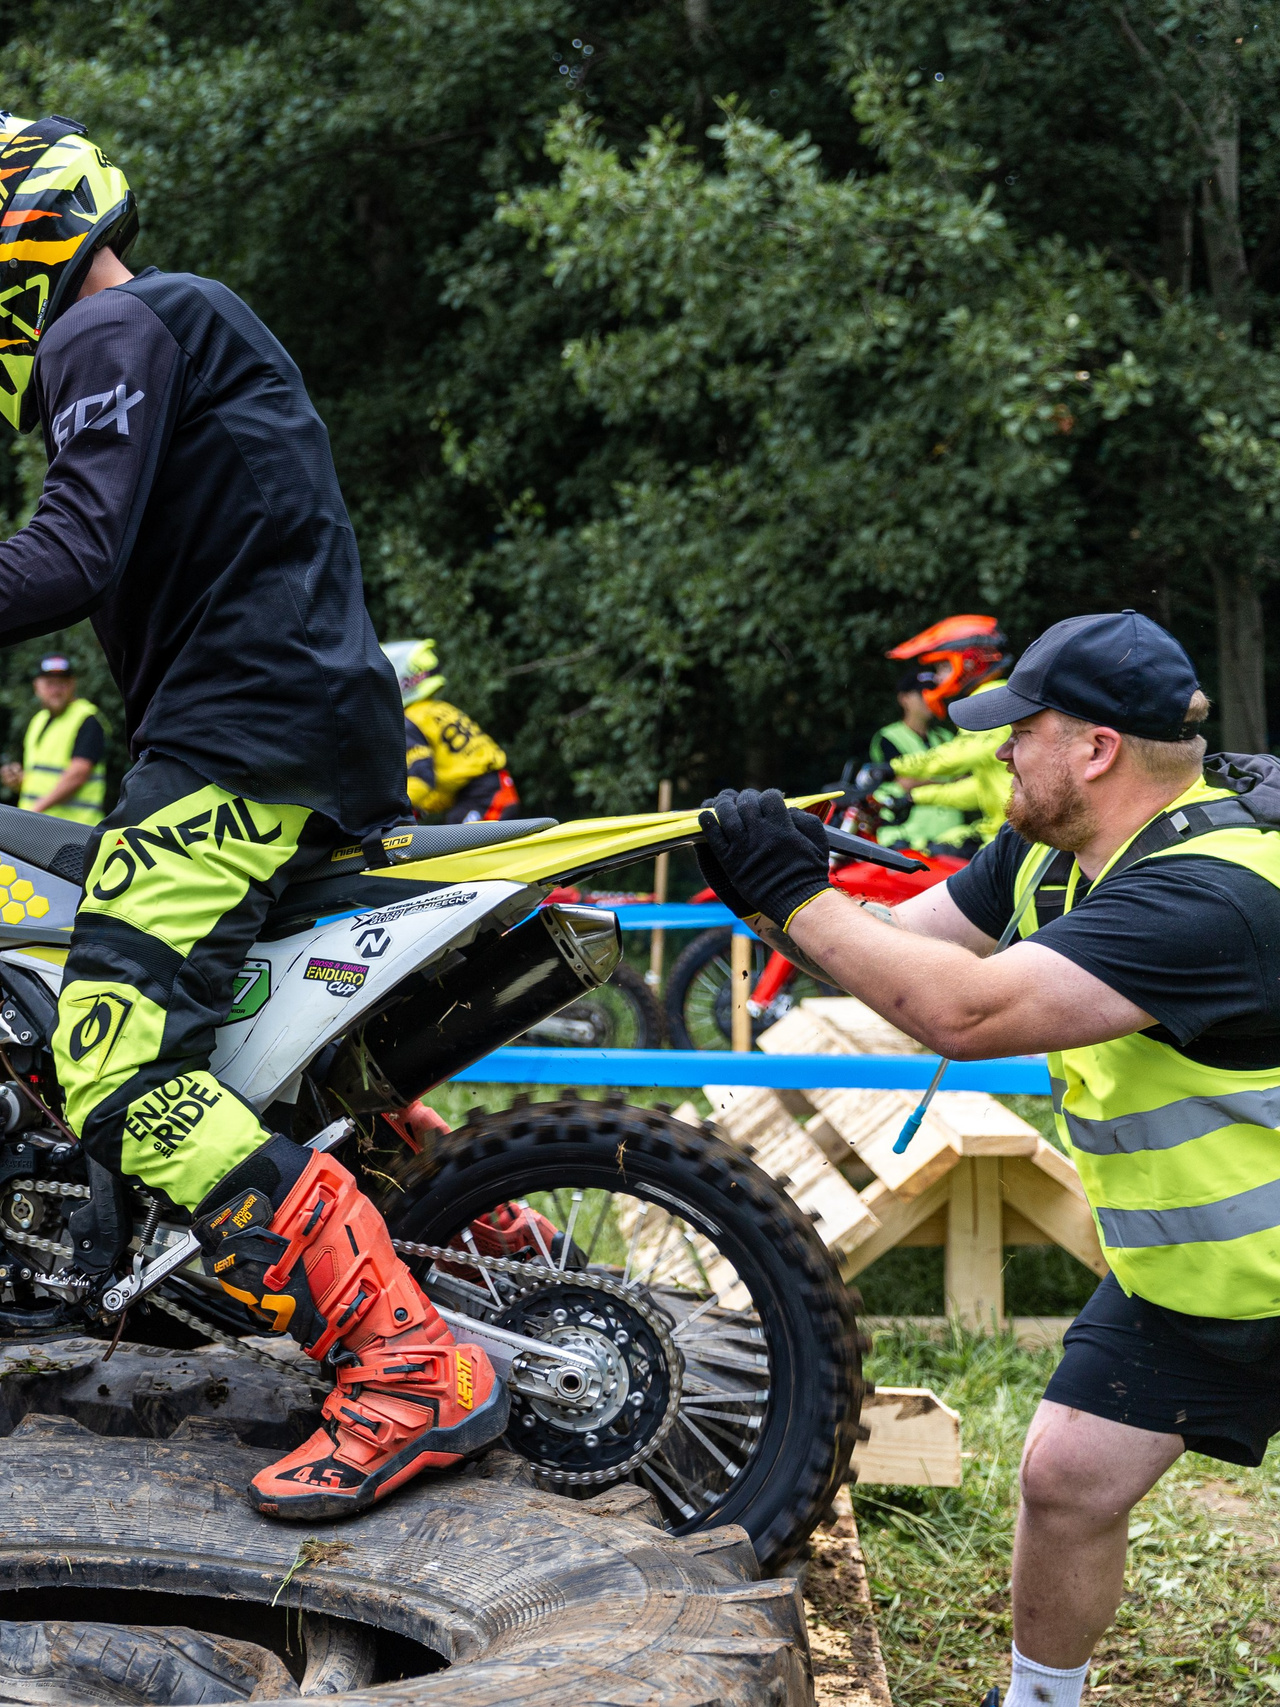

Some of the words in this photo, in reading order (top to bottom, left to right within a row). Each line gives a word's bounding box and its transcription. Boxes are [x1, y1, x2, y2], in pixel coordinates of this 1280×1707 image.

[52, 384, 145, 451] FOX
[335, 846, 363, 857] NIBB
[382, 837, 409, 848] CING
[306, 966, 365, 986] ENDURO
[309, 960, 334, 968] CROSS
[341, 964, 367, 973] JUNIOR
[328, 981, 357, 995] CUP
[154, 1141, 174, 1159] the
[236, 1211, 253, 1229] EVO
[214, 1253, 236, 1273] LEATT
[455, 1351, 475, 1410] LEATT
[293, 1466, 344, 1488] 4.5
